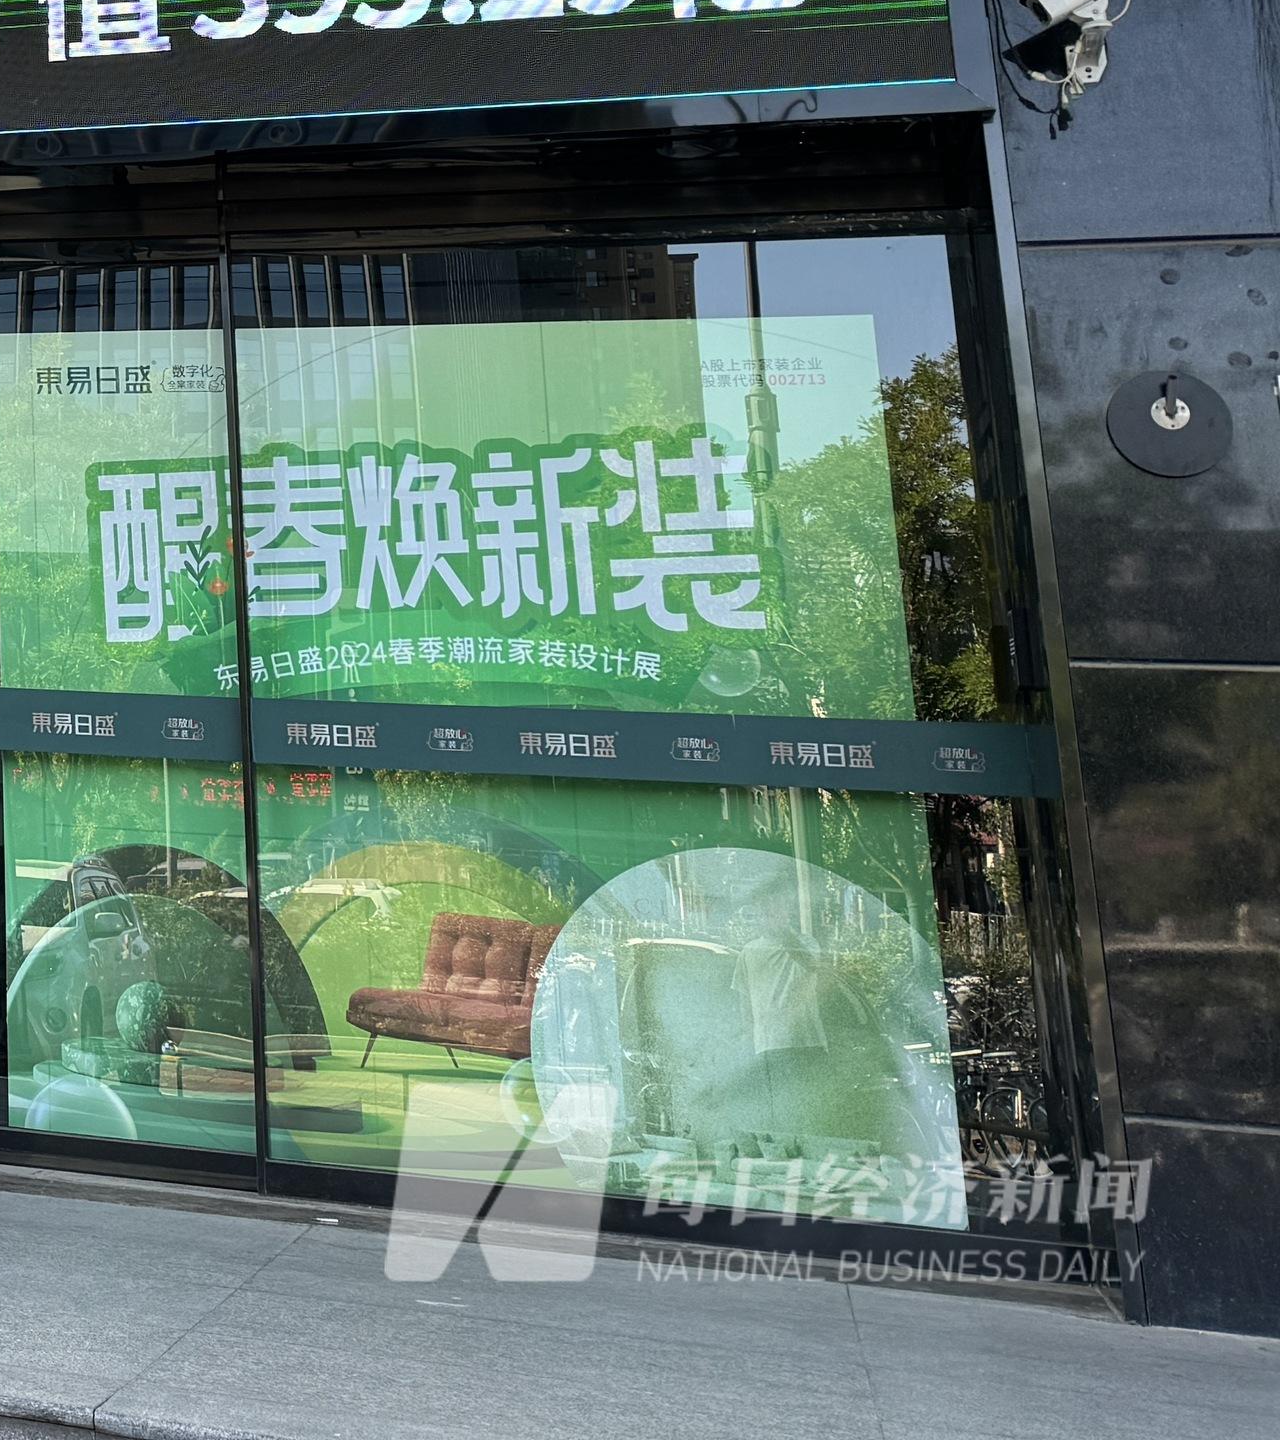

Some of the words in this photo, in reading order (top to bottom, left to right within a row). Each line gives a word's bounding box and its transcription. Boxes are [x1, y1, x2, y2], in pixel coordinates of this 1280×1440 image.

[36, 366, 153, 394] 東易日盛
[172, 364, 213, 378] 数字化
[768, 373, 826, 386] 002713
[32, 713, 115, 737] 東易日盛
[287, 723, 377, 748] 東易日盛
[520, 732, 616, 758] 東易日盛
[769, 742, 874, 768] 東易日盛
